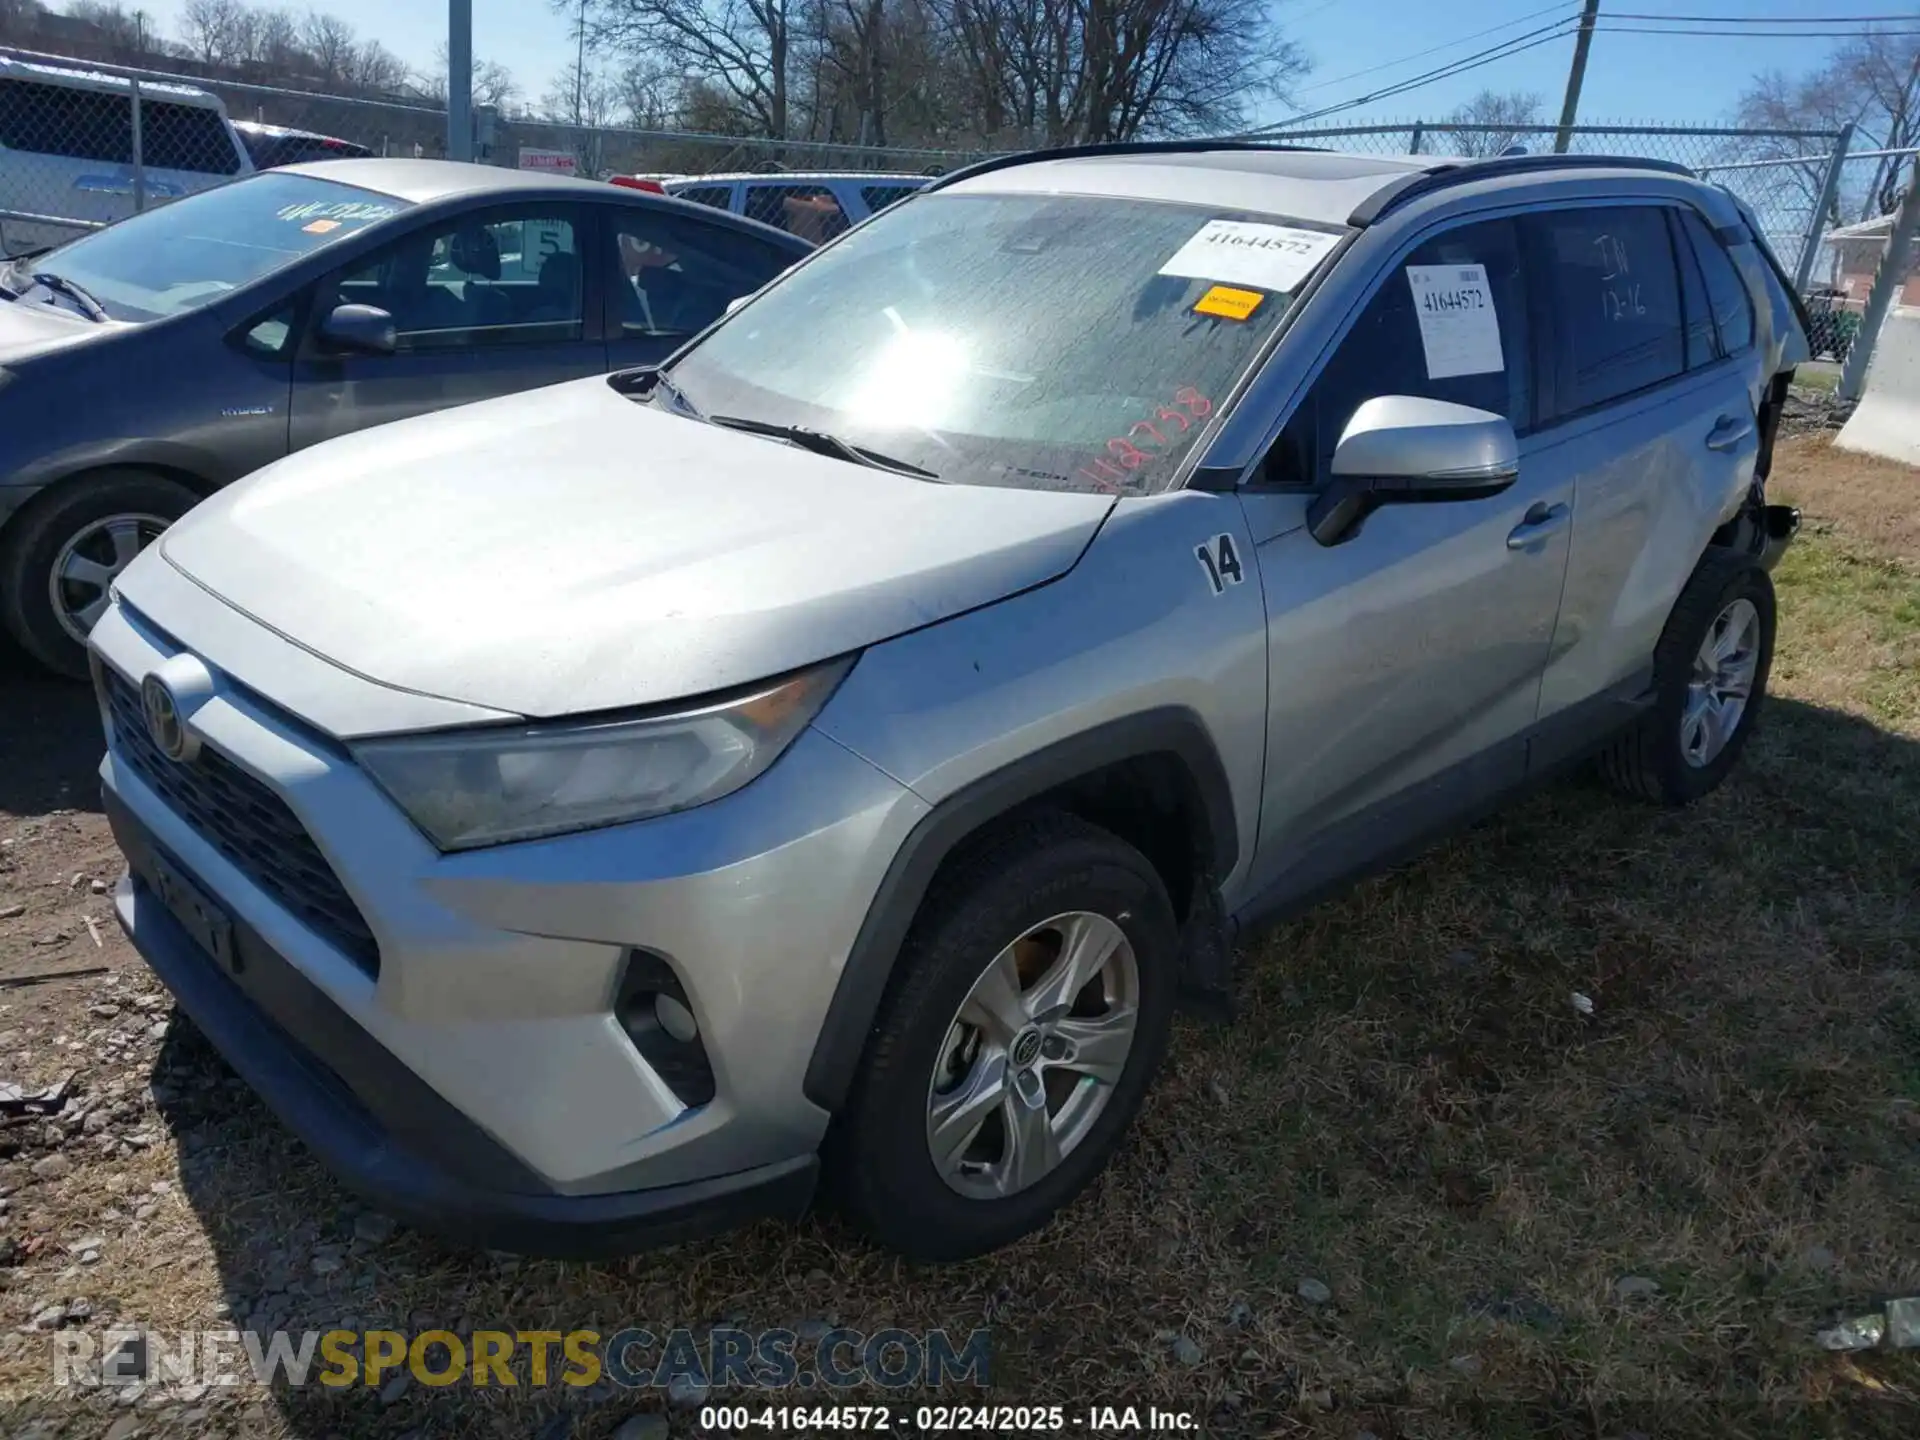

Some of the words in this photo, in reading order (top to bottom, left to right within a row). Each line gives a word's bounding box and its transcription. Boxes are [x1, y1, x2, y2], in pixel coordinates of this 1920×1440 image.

[1207, 232, 1312, 254] 41644572
[1423, 289, 1484, 312] 41644572
[1197, 534, 1242, 593] 14
